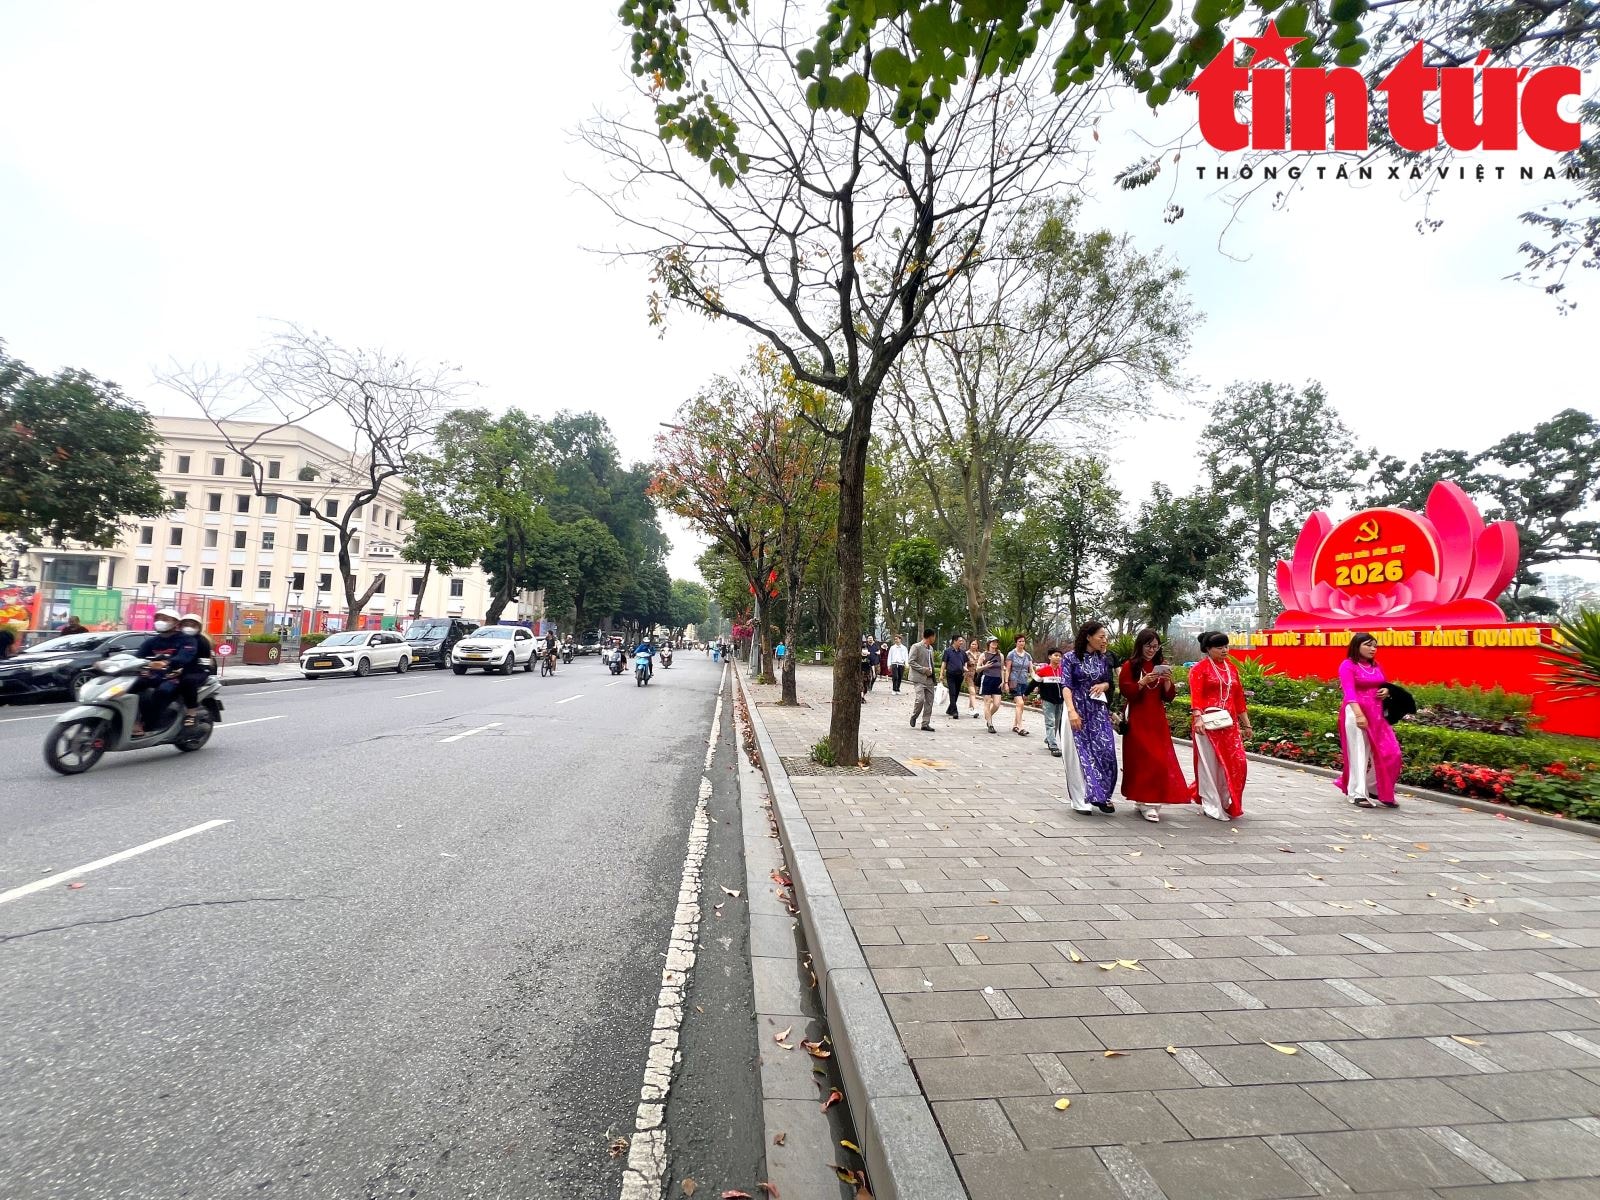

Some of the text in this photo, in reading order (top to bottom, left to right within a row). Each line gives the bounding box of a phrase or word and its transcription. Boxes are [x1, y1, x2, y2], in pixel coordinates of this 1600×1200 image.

[1336, 559, 1403, 586] 2026
[1420, 624, 1469, 647] ĐẢNG
[1472, 627, 1541, 648] QUANG
